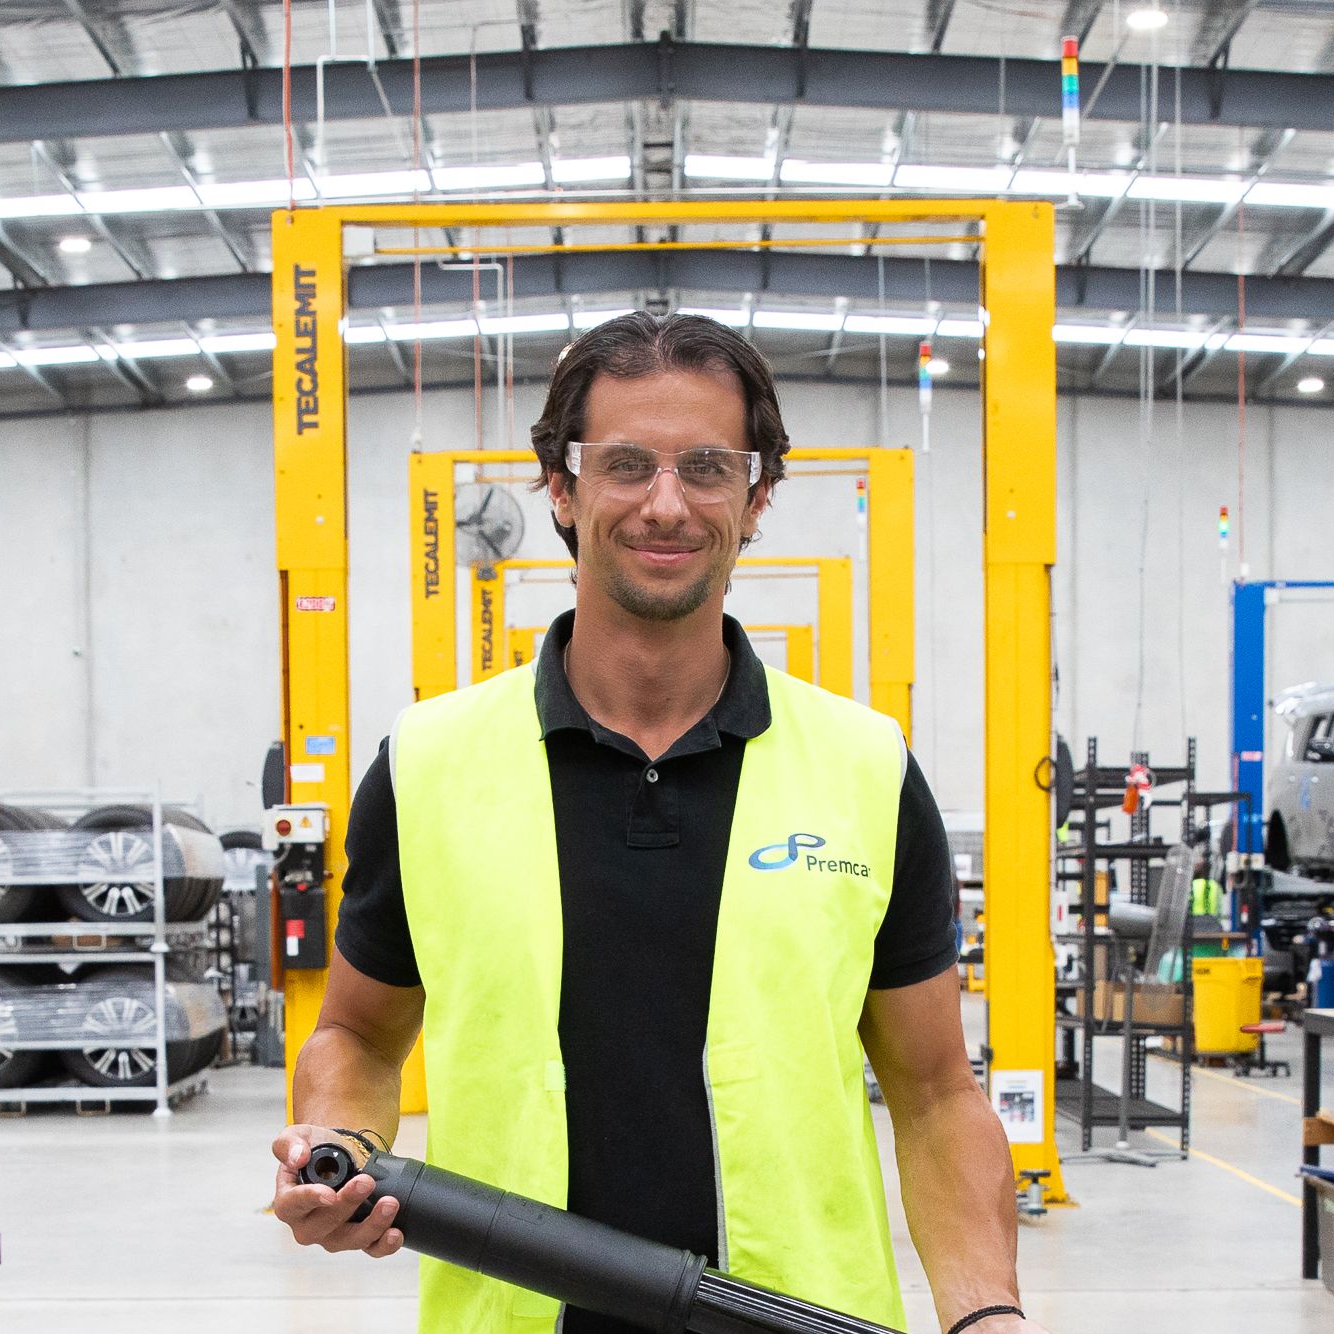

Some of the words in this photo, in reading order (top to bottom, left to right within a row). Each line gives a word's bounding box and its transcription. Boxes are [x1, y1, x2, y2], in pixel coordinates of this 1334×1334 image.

[293, 264, 319, 435] TECALEMIT
[424, 488, 440, 599] TECALEMIT
[481, 588, 494, 672] TECALEMIT
[806, 855, 871, 878] Premca
